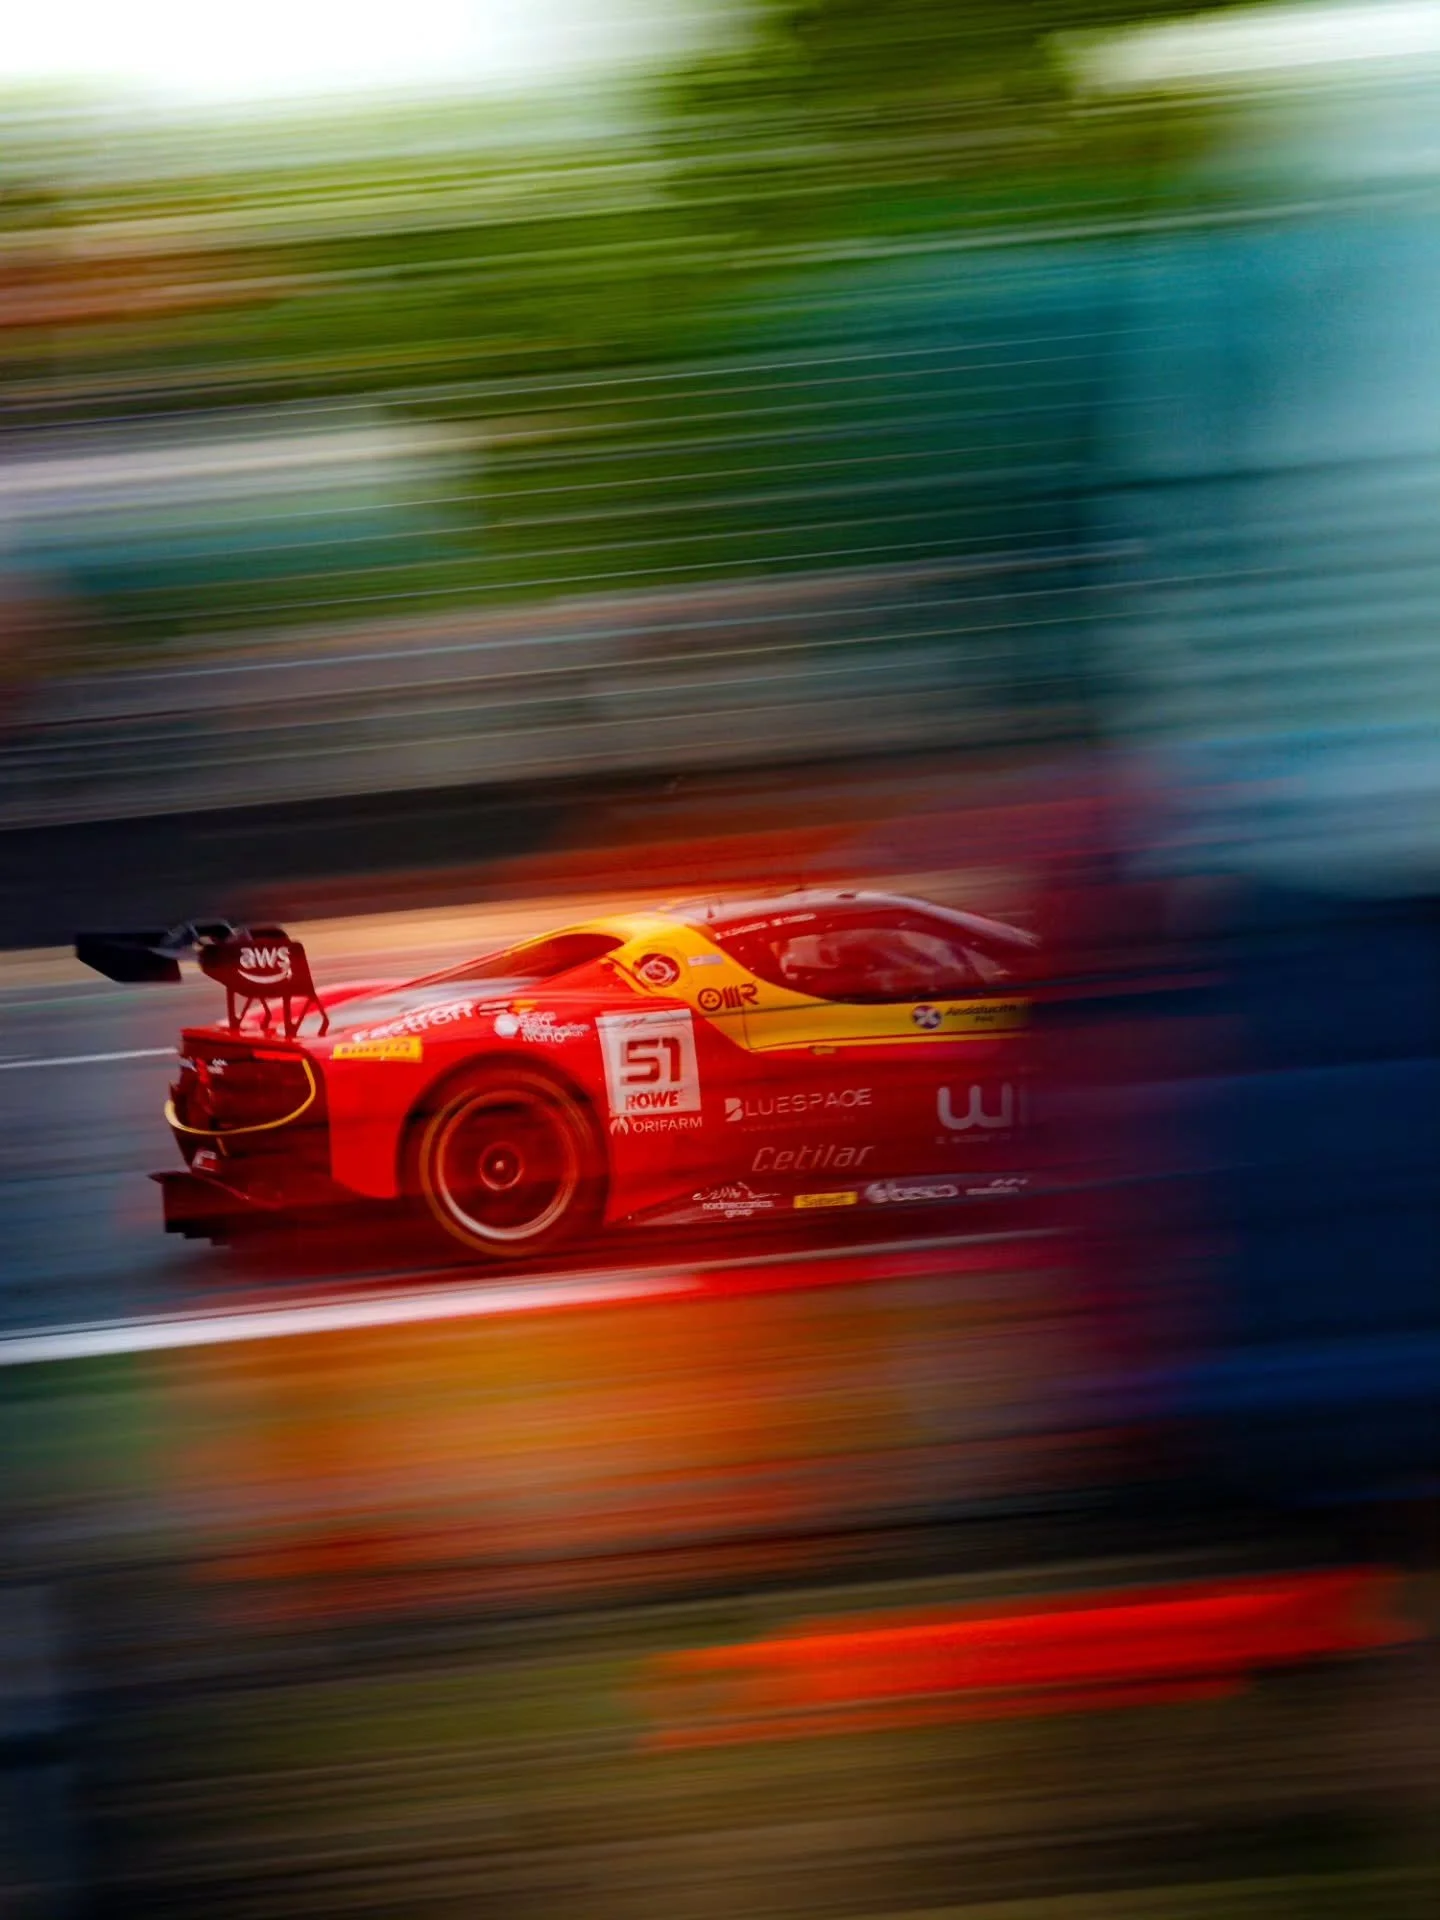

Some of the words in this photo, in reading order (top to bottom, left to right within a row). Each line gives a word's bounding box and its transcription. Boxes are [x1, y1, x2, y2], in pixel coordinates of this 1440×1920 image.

[239, 946, 290, 969] aws
[626, 1036, 681, 1084] 51
[625, 1089, 682, 1111] ROWE
[632, 1116, 703, 1134] ORIFARM
[751, 1144, 875, 1172] Cetilar
